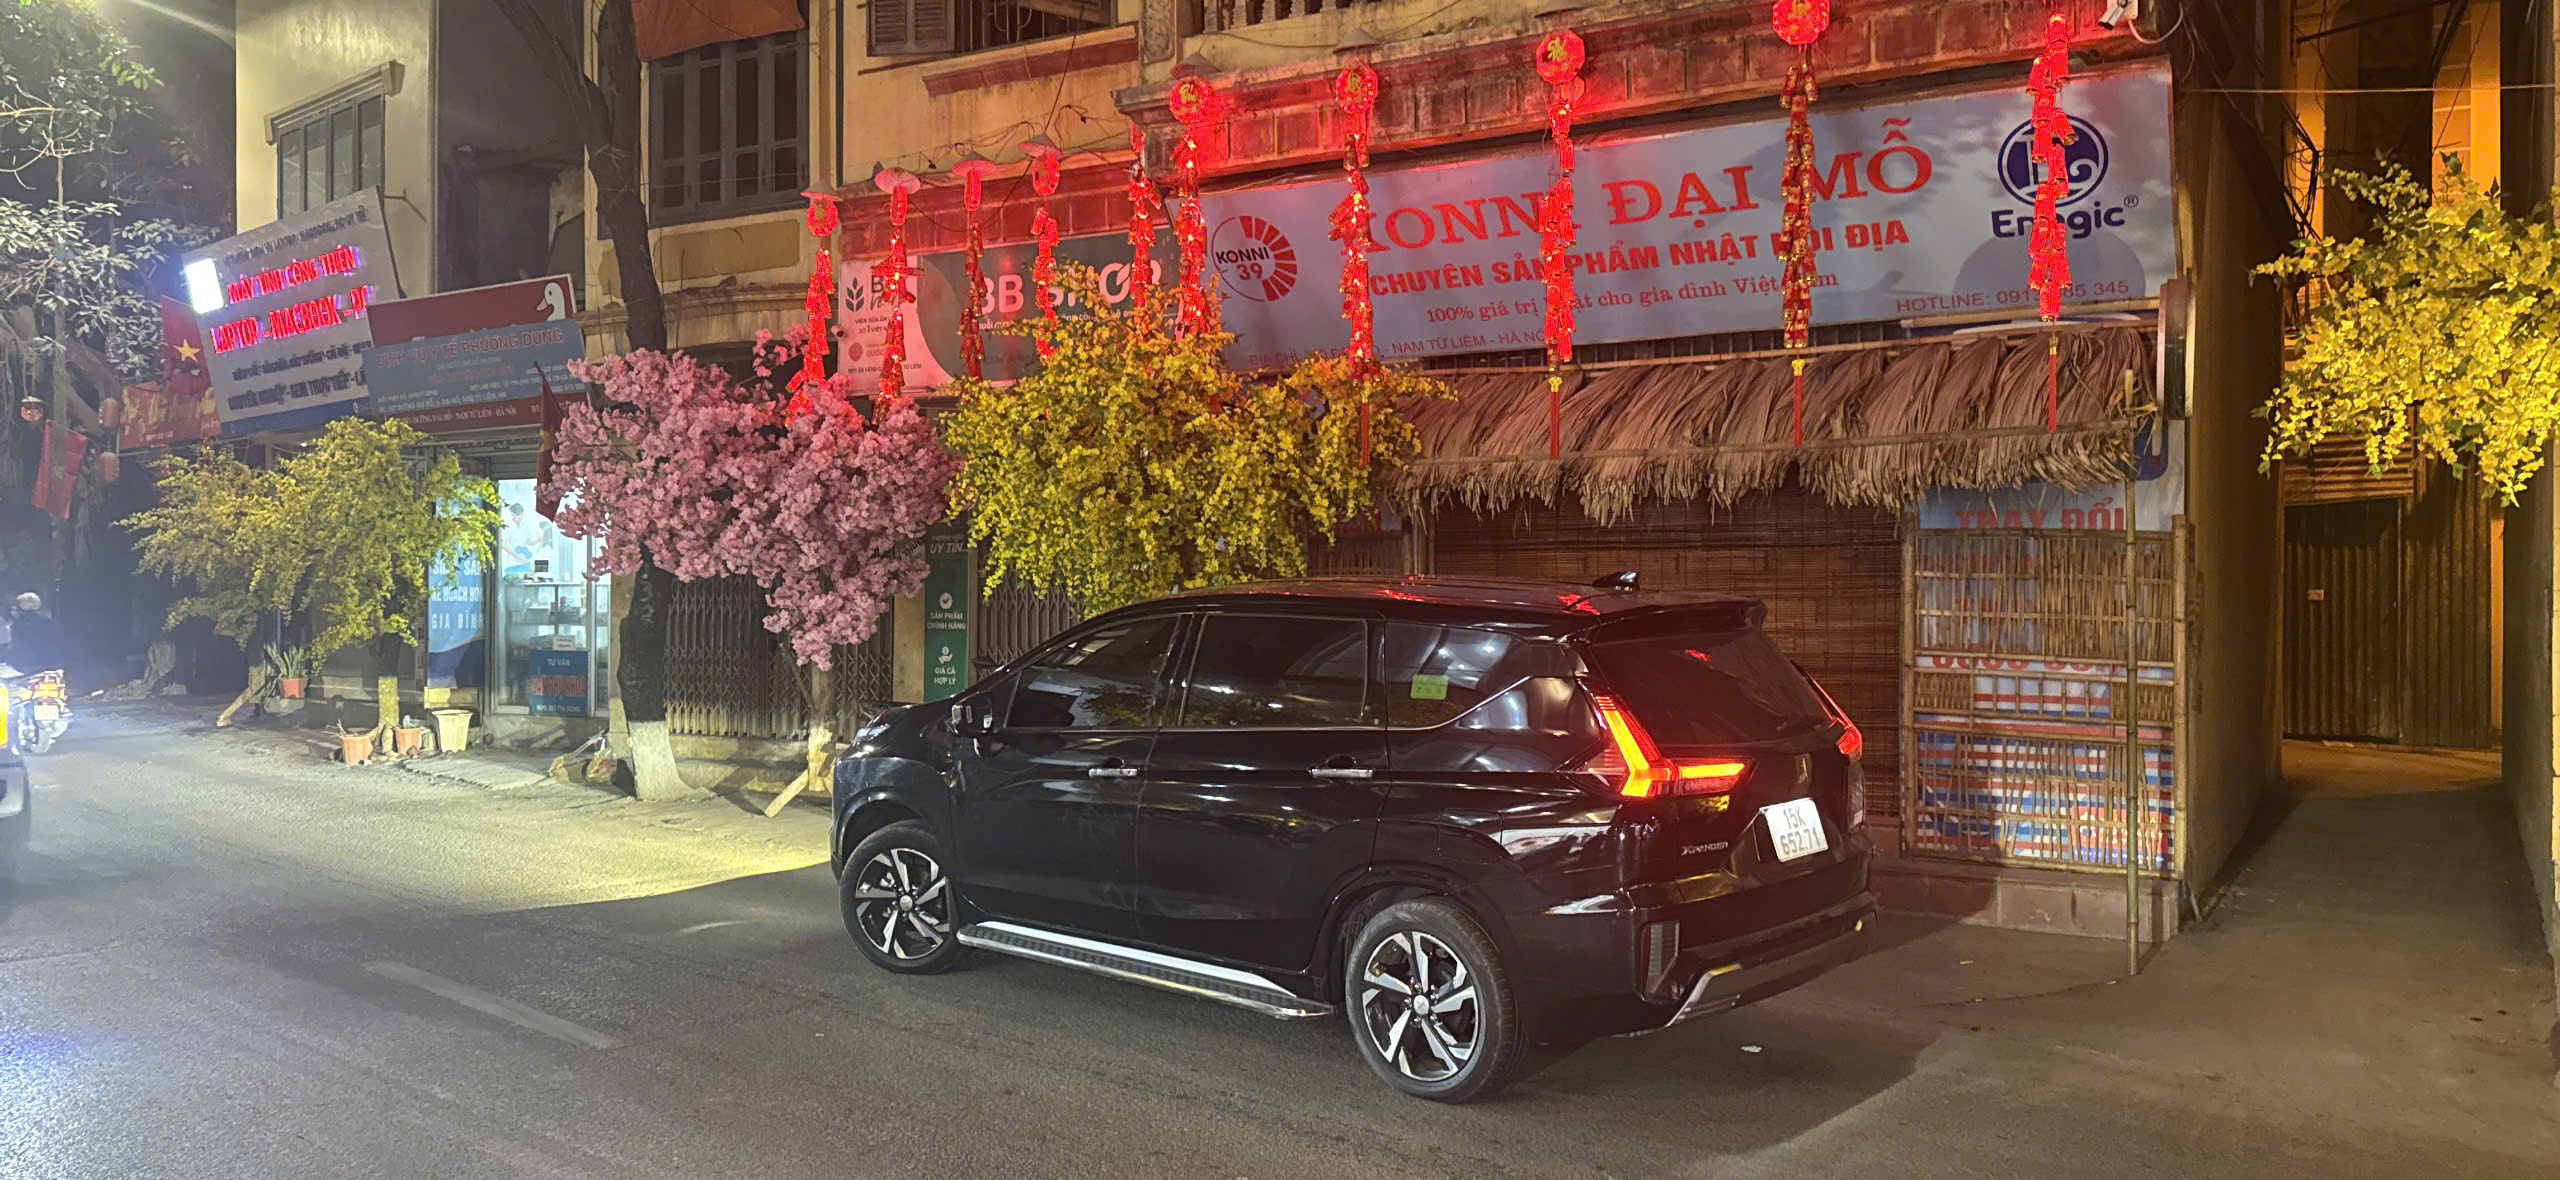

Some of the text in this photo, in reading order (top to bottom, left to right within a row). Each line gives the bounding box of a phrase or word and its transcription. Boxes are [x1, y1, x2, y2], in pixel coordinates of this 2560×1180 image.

[1340, 117, 1932, 257] ONN ĐẠI MỖ
[1991, 200, 2126, 239] Engic
[1215, 246, 1270, 265] KONNI
[1236, 262, 1263, 281] 39
[1368, 262, 1485, 297] CHUYÊN
[1563, 239, 1660, 276] PHẨM
[1671, 233, 1759, 267] NHẬT
[1845, 220, 1910, 252] ĐỊA
[970, 274, 1024, 316] BB
[1426, 304, 1475, 323] 100%
[1479, 298, 1510, 321] giá
[1513, 298, 1539, 317] trị
[1597, 290, 1633, 307] cho
[1638, 286, 1673, 308] gia
[1678, 280, 1727, 300] đình
[1732, 274, 1780, 297] Việt
[1896, 292, 1990, 313] HOTLINE:
[2093, 278, 2130, 297] 345
[210, 315, 260, 354] LAPTOP
[268, 294, 342, 340] MACBOOK
[523, 327, 564, 347] DUNG
[1391, 339, 1425, 354] NAM
[1783, 806, 1807, 830] 15K
[1681, 841, 1729, 856] XPANDER
[1779, 826, 1822, 856] 652.71
